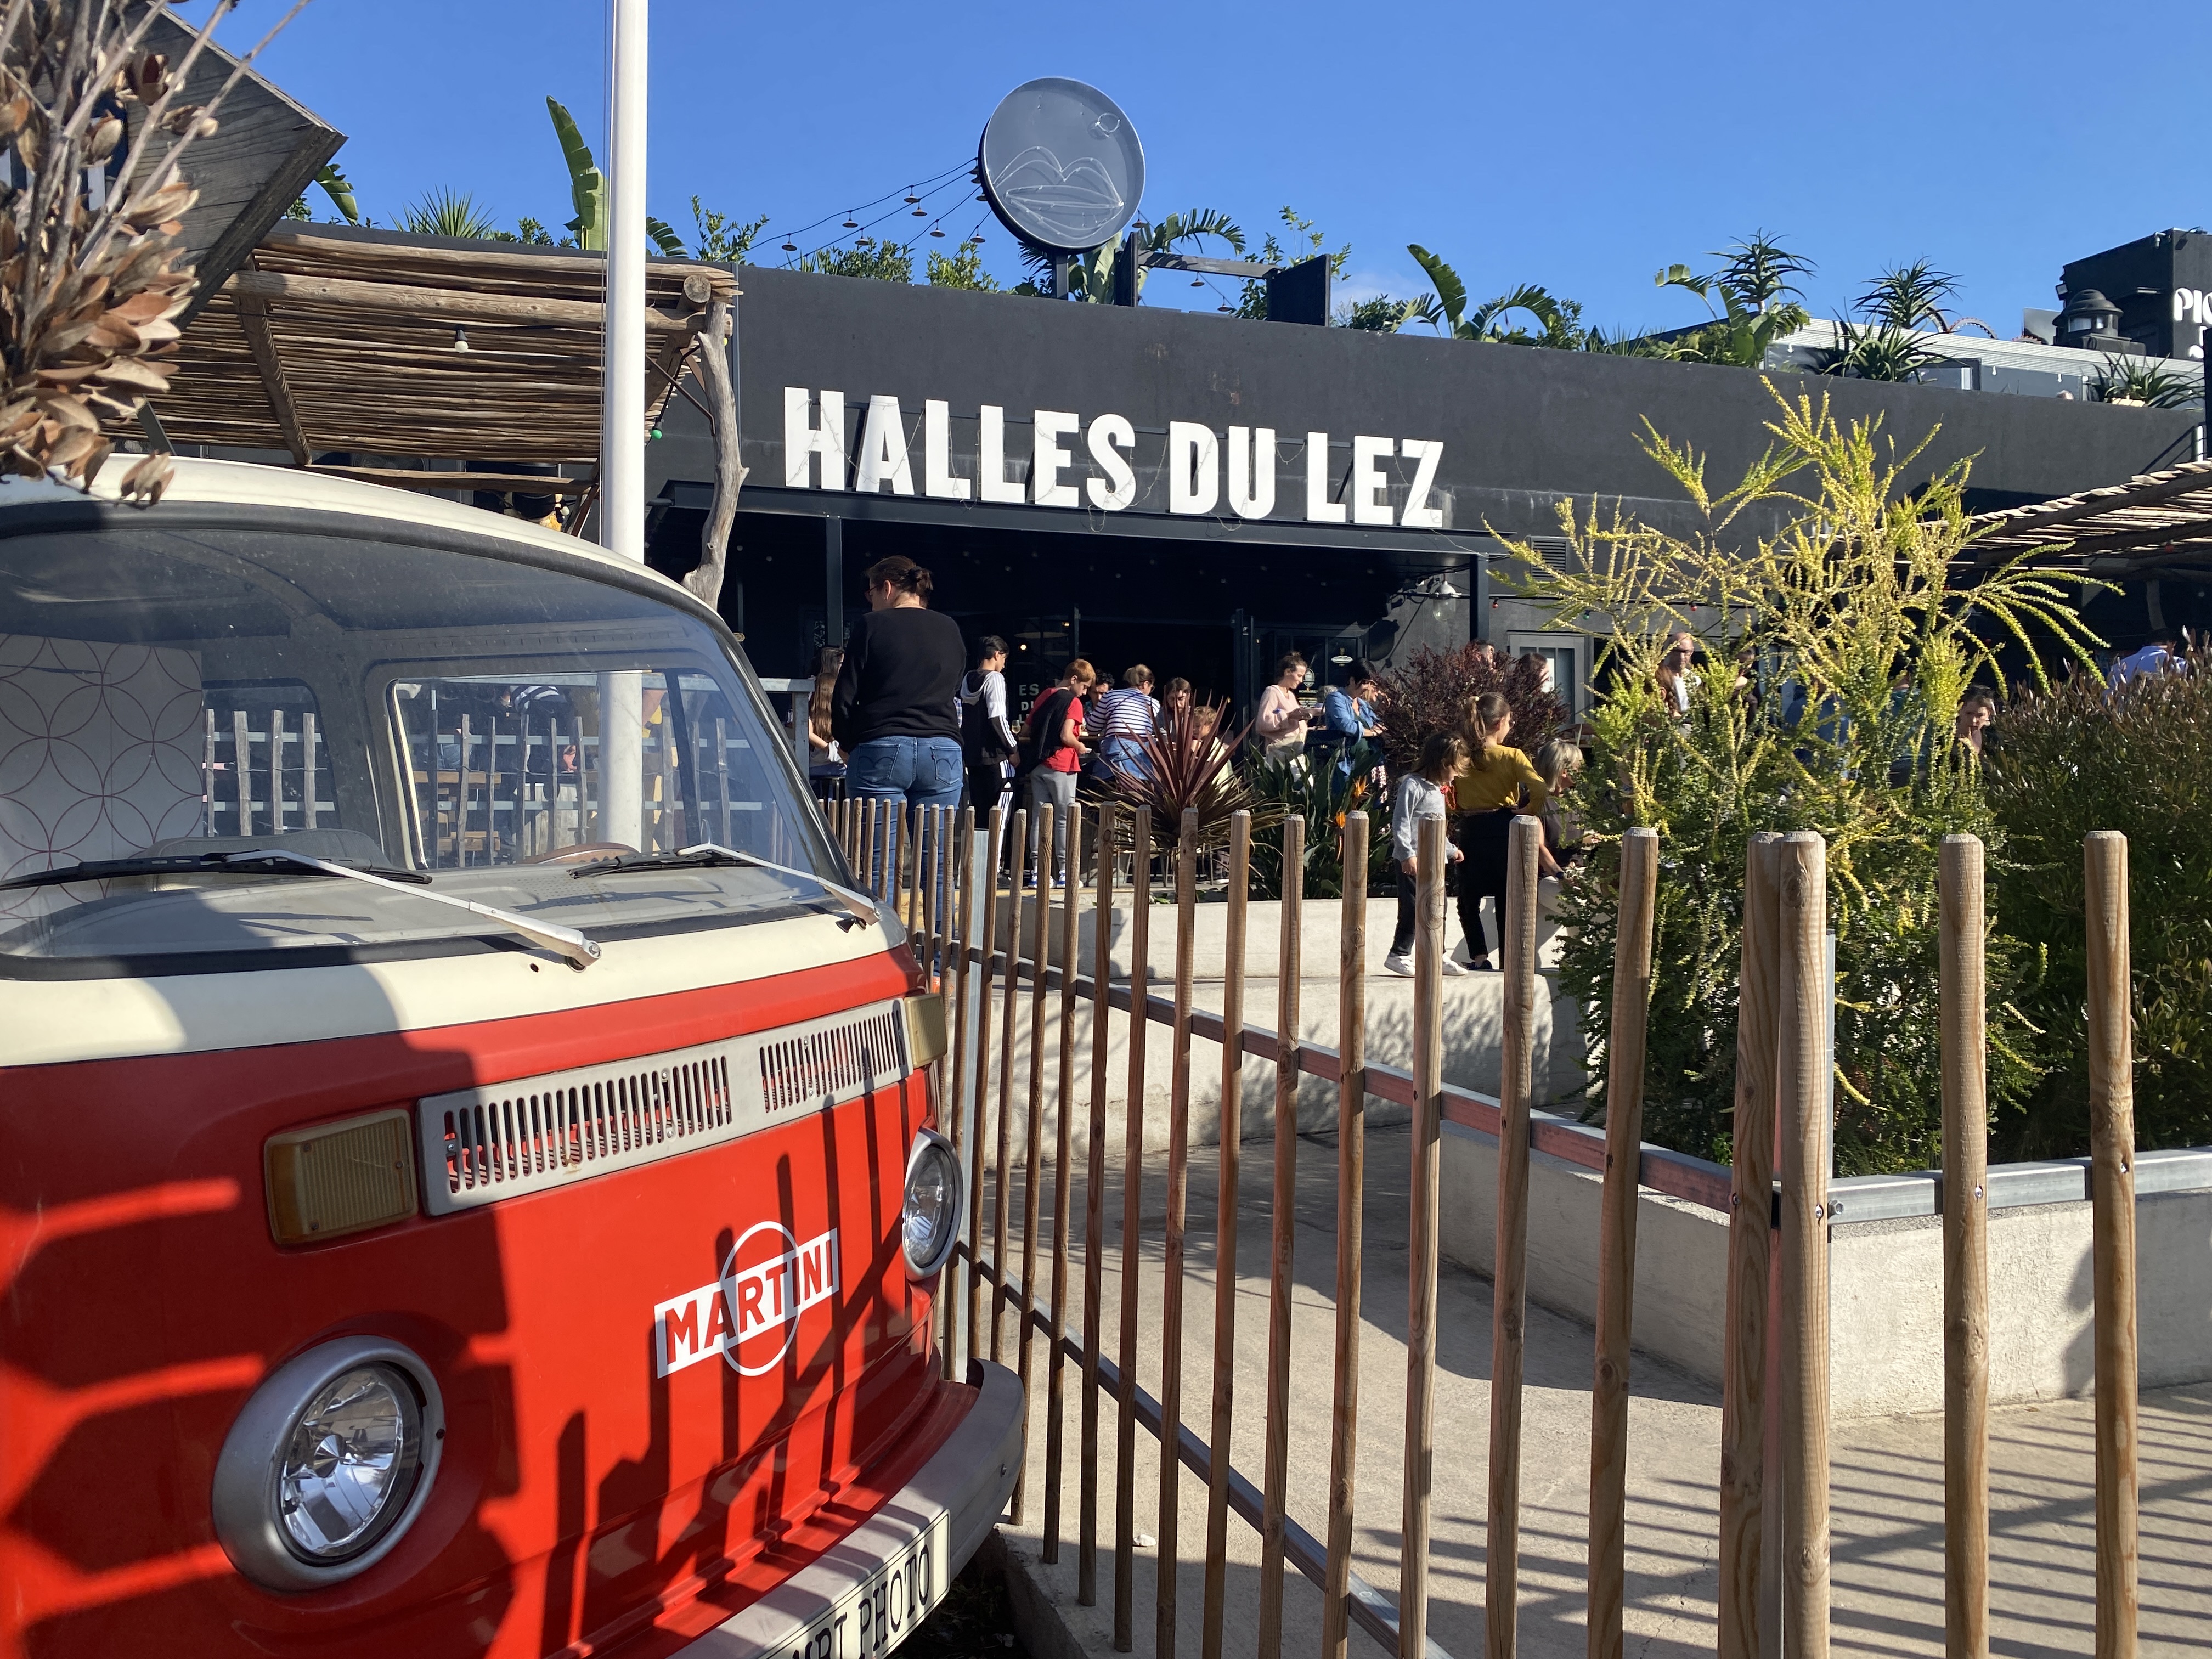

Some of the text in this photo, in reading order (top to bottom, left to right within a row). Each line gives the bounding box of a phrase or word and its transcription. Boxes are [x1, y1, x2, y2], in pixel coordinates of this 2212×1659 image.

[785, 387, 1443, 528] HALLES DU LEZ
[1019, 684, 1039, 696] ES
[665, 1239, 833, 1365] MARTINI
[857, 1544, 930, 1659] PHOTO
